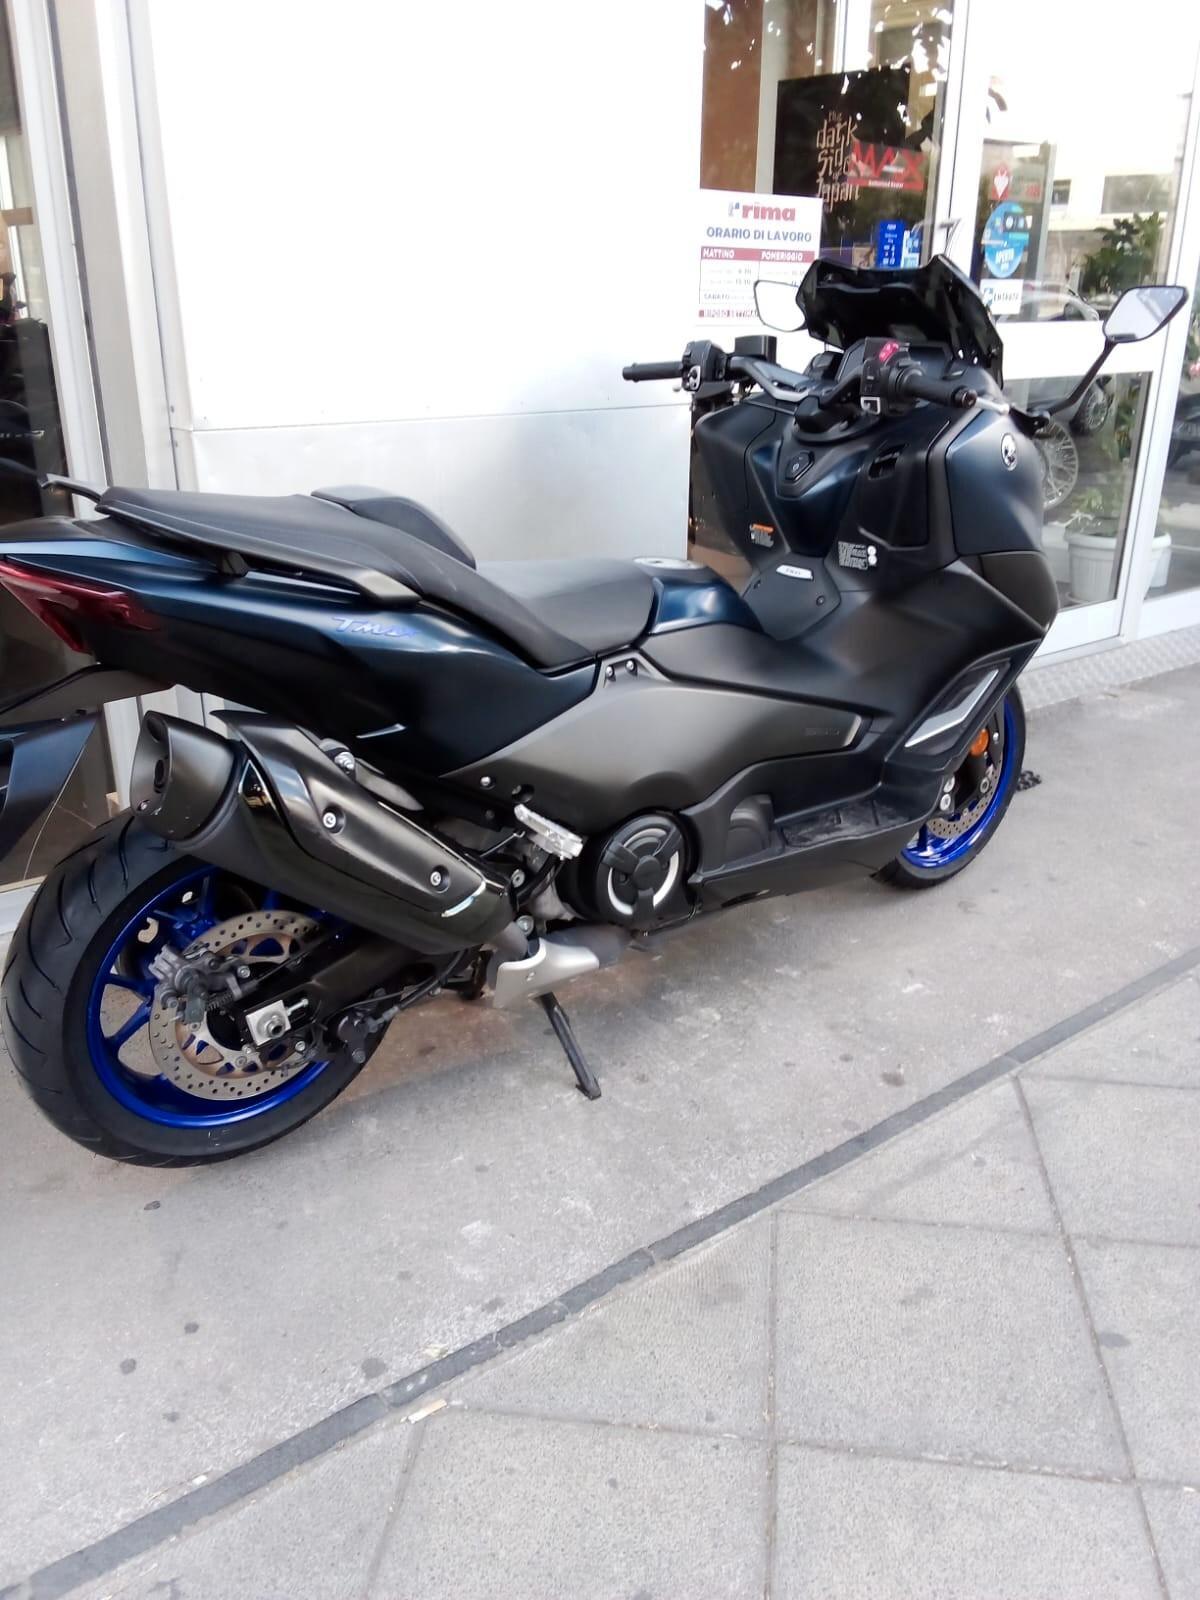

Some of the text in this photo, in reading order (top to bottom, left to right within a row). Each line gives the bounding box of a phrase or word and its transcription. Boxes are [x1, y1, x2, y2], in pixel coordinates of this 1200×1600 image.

[706, 226, 812, 242] ORARIO DI LAVORO
[702, 248, 735, 258] MATTINO
[761, 251, 804, 261] POMERIGGIO
